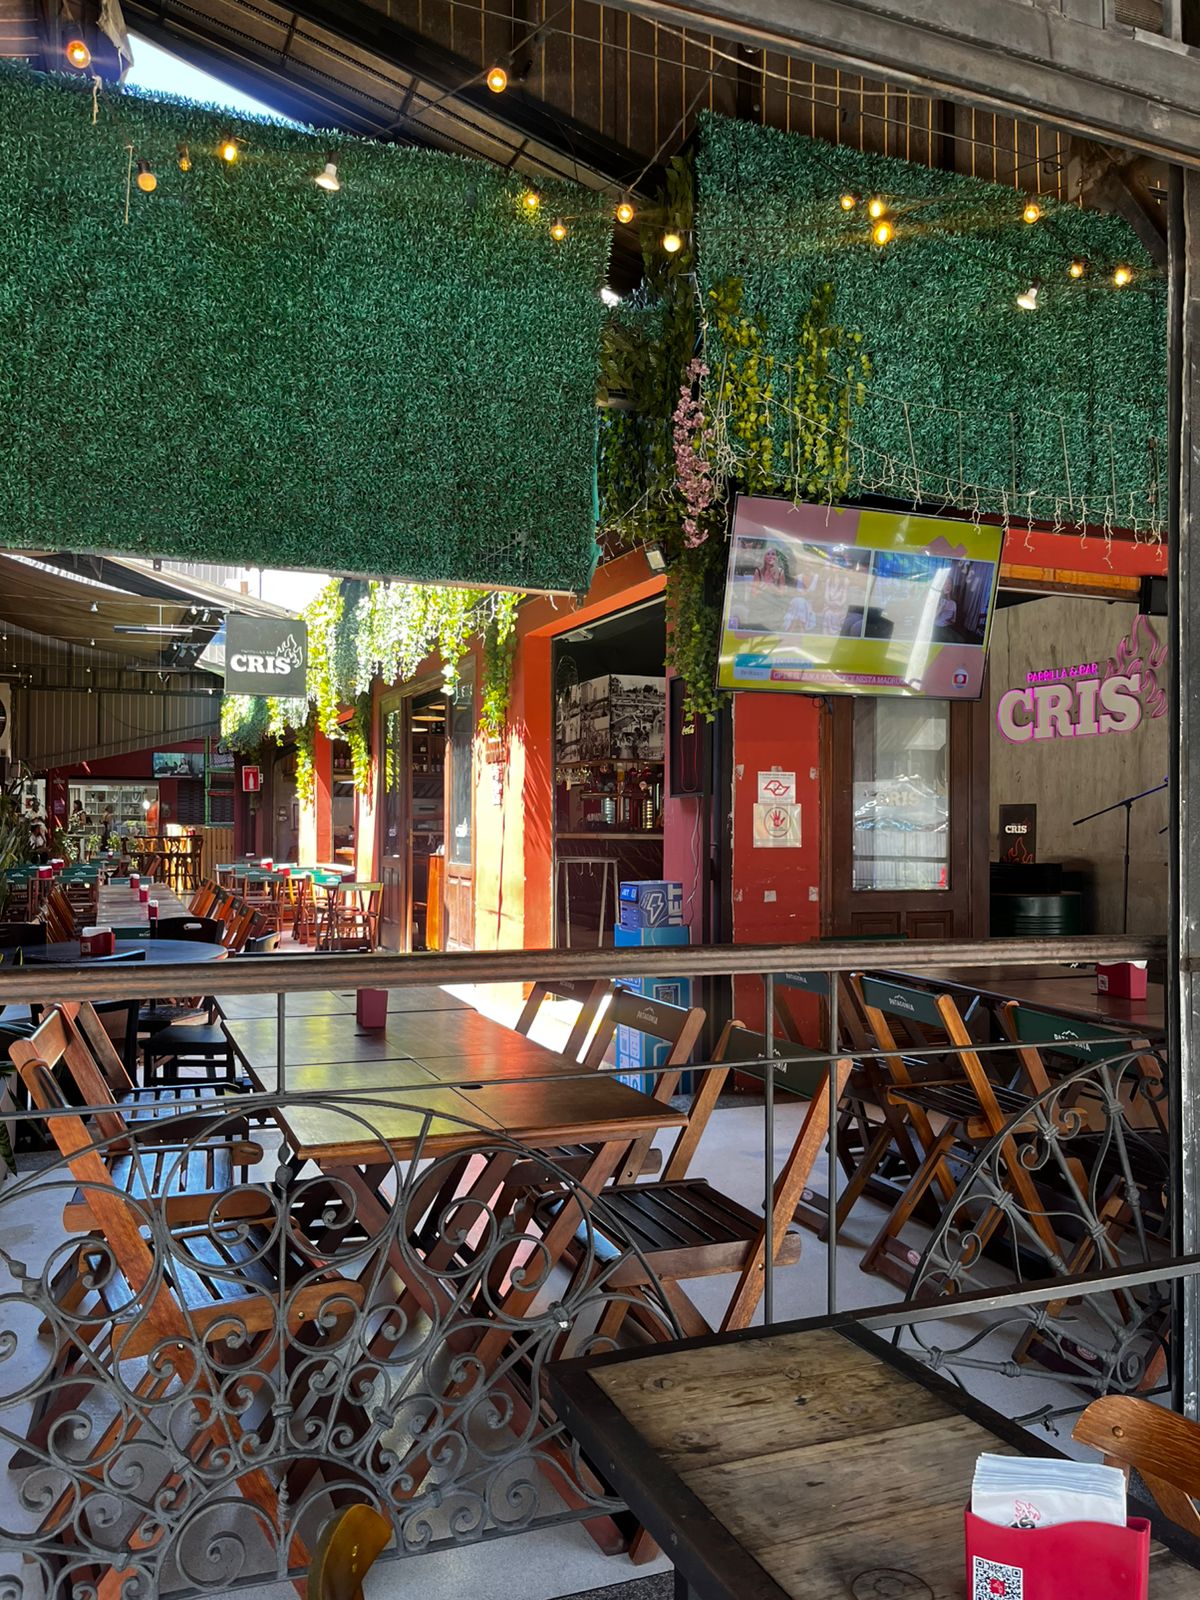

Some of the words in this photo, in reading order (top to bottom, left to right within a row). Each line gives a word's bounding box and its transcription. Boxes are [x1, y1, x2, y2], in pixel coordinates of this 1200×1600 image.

[230, 654, 291, 675] CRIS
[1026, 668, 1067, 683] PARRILLA
[1069, 666, 1077, 678] &
[1078, 662, 1099, 677] BAR
[997, 673, 1142, 744] CRIS
[1005, 825, 1027, 834] CRIS
